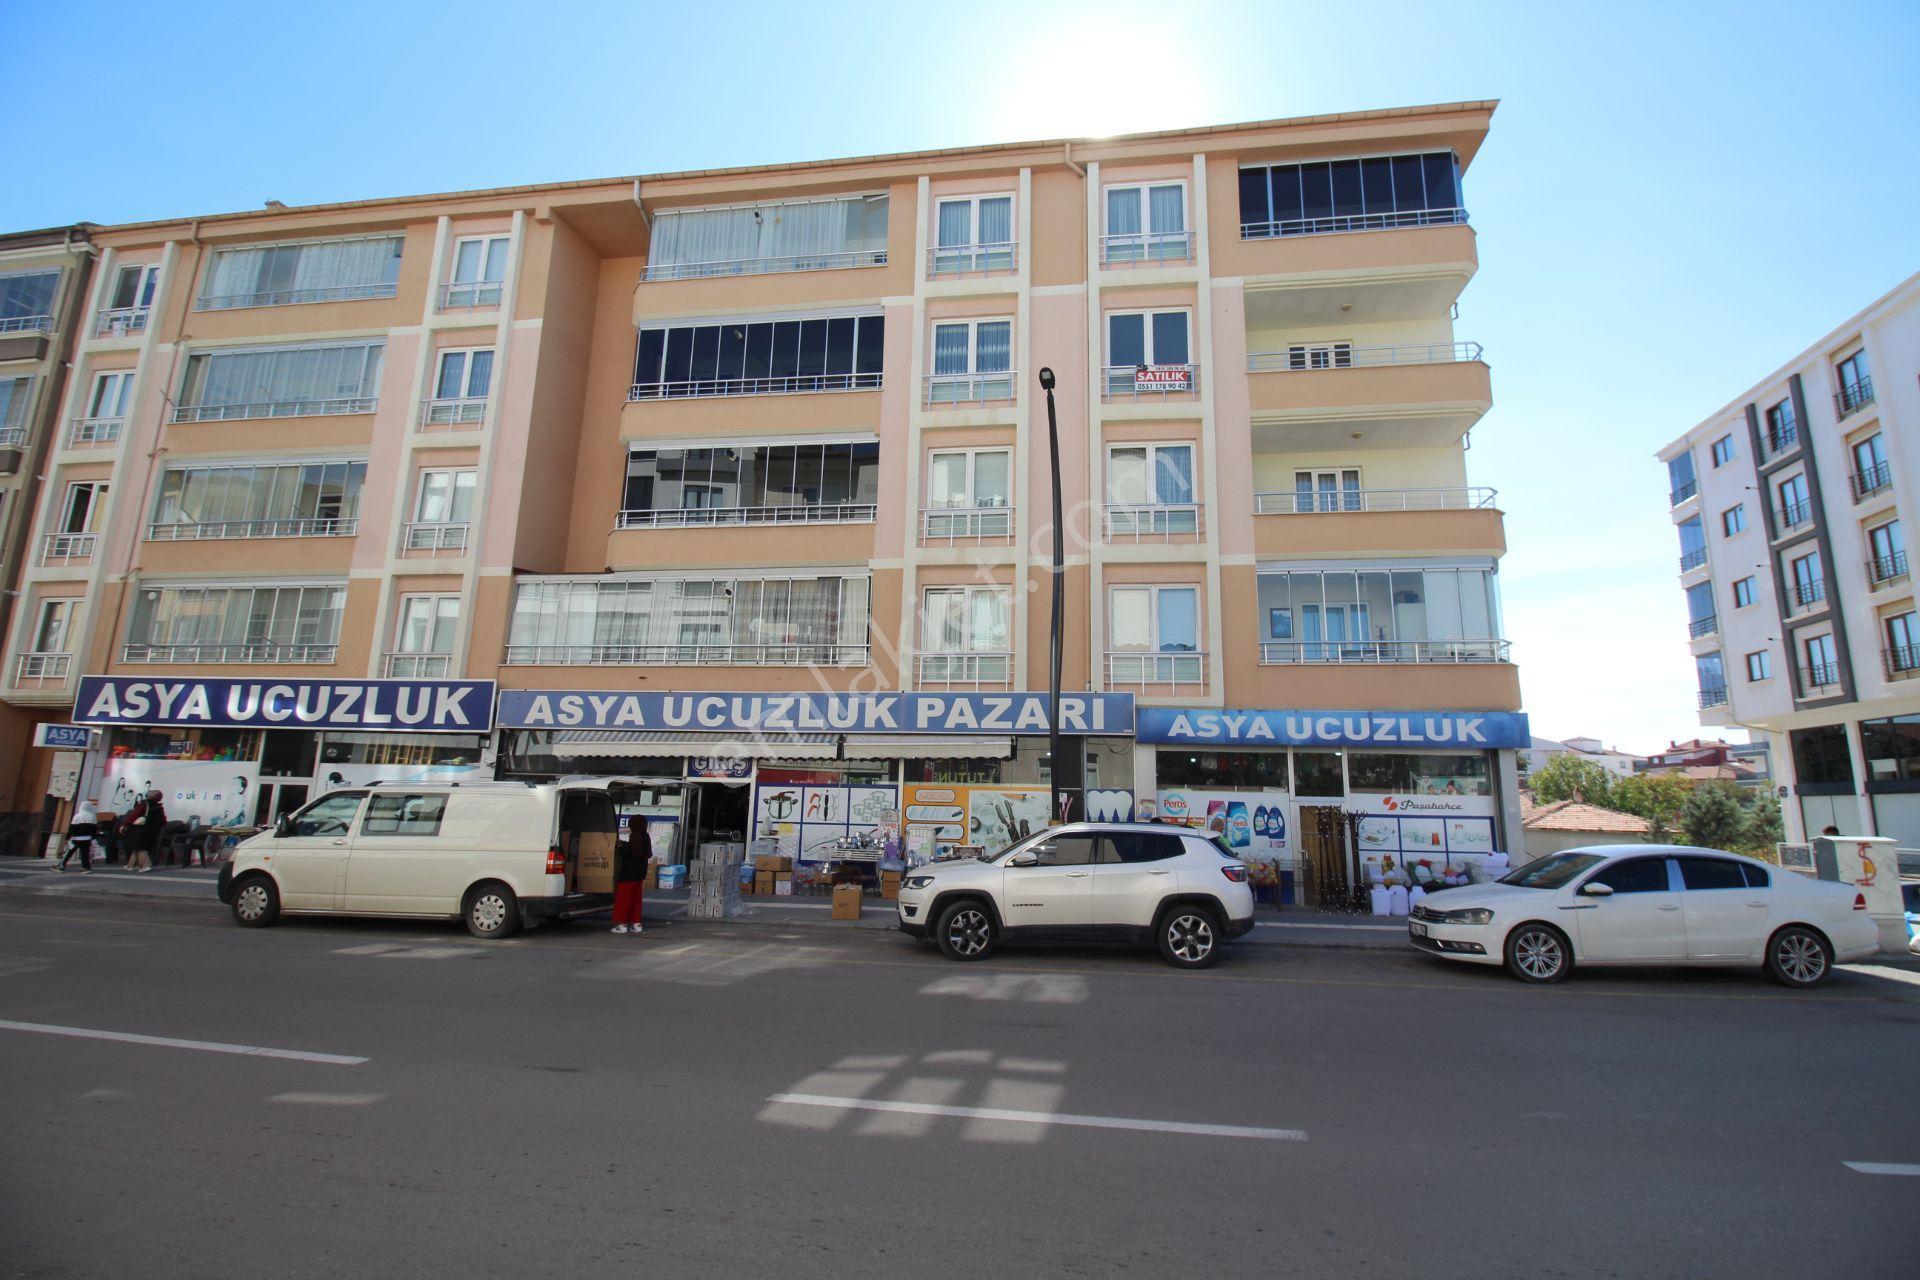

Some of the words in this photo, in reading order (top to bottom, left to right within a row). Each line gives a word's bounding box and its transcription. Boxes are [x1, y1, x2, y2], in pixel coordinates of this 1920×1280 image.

[1138, 372, 1185, 381] SATILIK
[86, 681, 212, 721] ASYA
[226, 684, 475, 725] UCUZLUK
[523, 694, 645, 726] ASYA
[662, 696, 899, 729] UCUZLUK
[916, 697, 1105, 730] PAZARI
[47, 728, 86, 741] ASYA
[1167, 714, 1275, 739] ASYA
[1286, 716, 1487, 742] UCUZLUK
[1163, 799, 1188, 808] Peros
